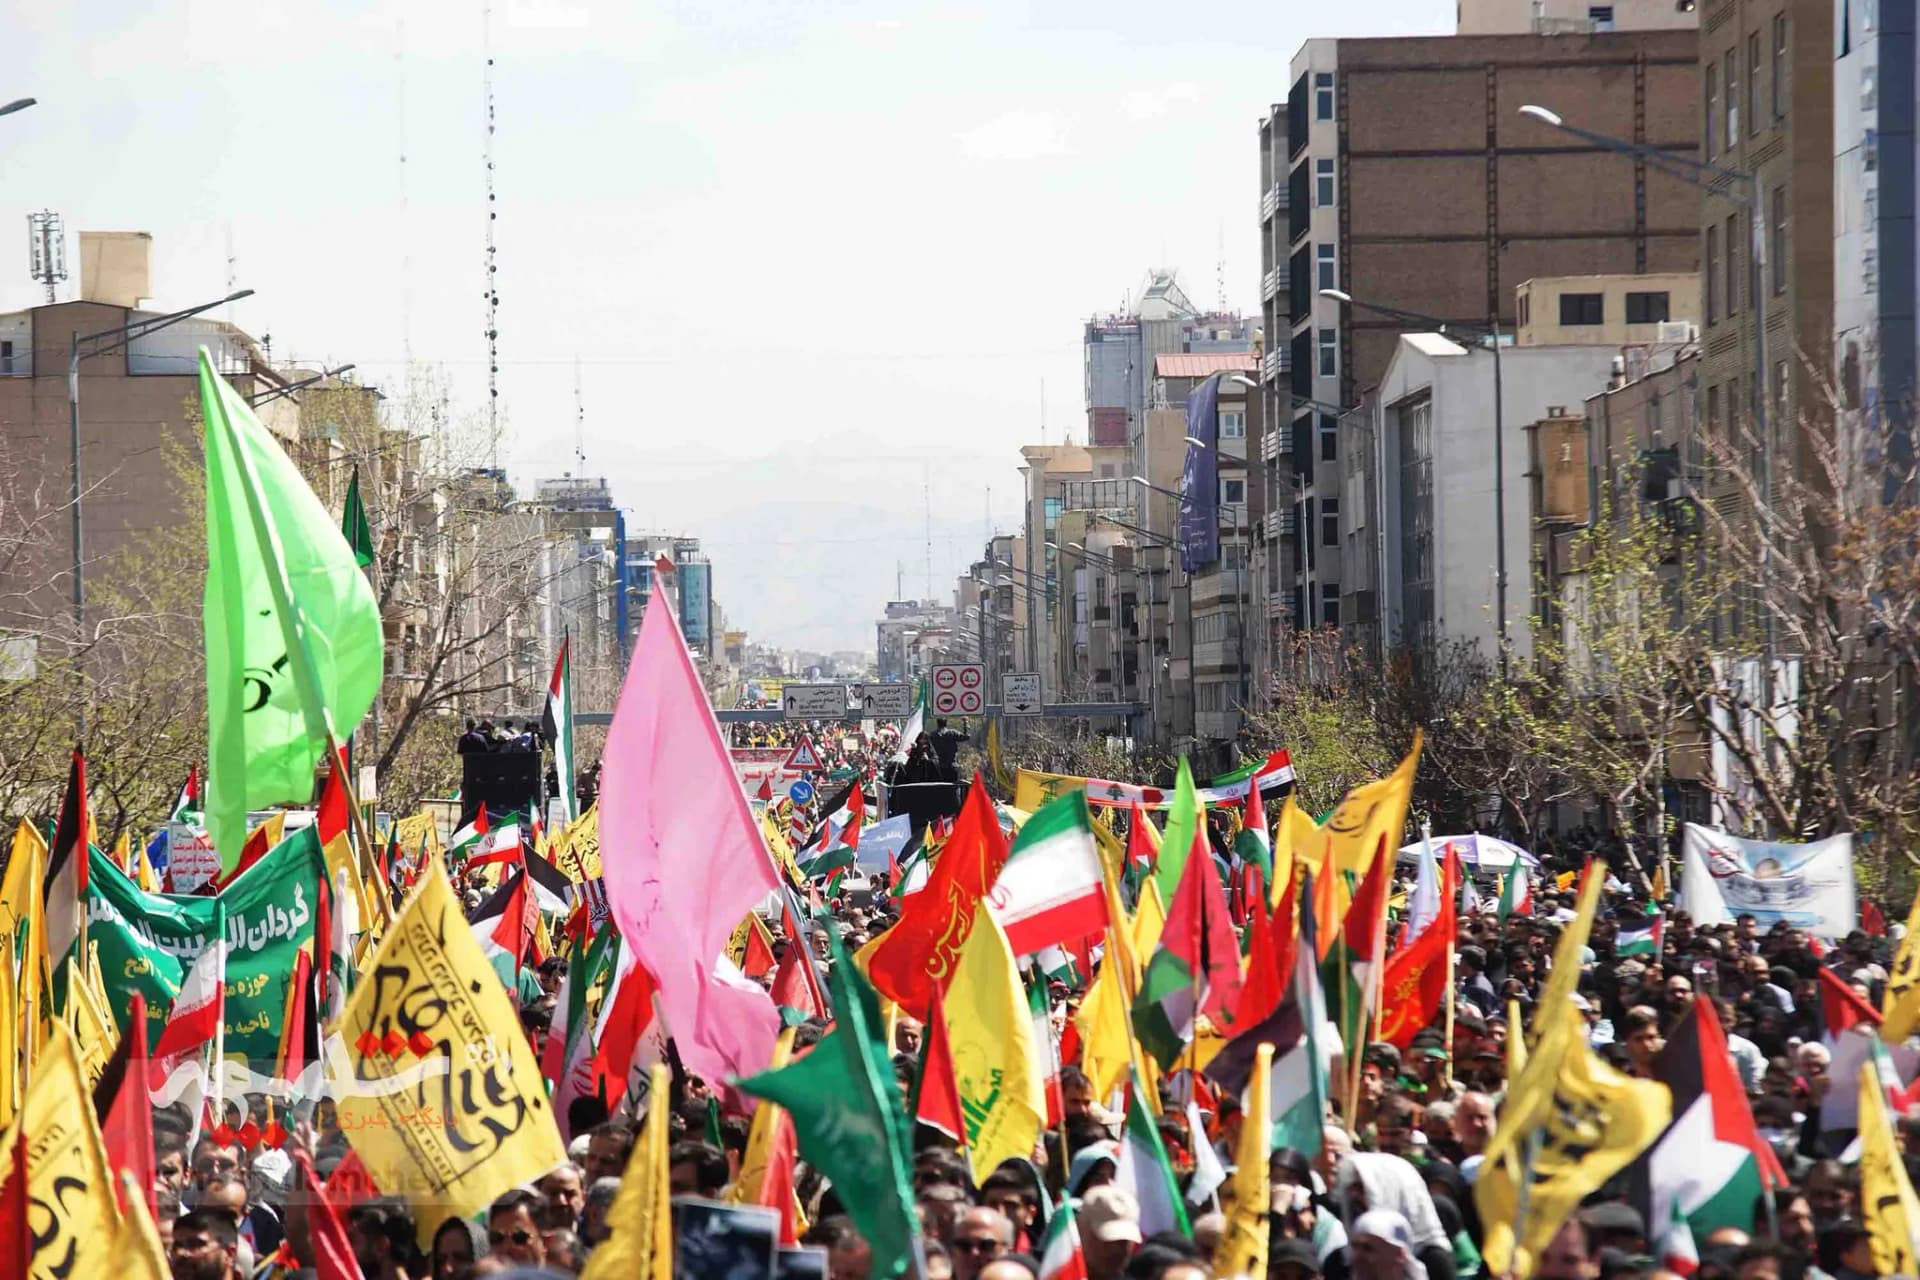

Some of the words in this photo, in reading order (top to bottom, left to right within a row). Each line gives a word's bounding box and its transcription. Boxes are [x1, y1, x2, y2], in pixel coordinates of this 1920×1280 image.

[247, 881, 310, 952] گردان
[155, 933, 205, 967] بیت
[237, 973, 270, 998] حوزه
[236, 1009, 270, 1037] ناحیه
